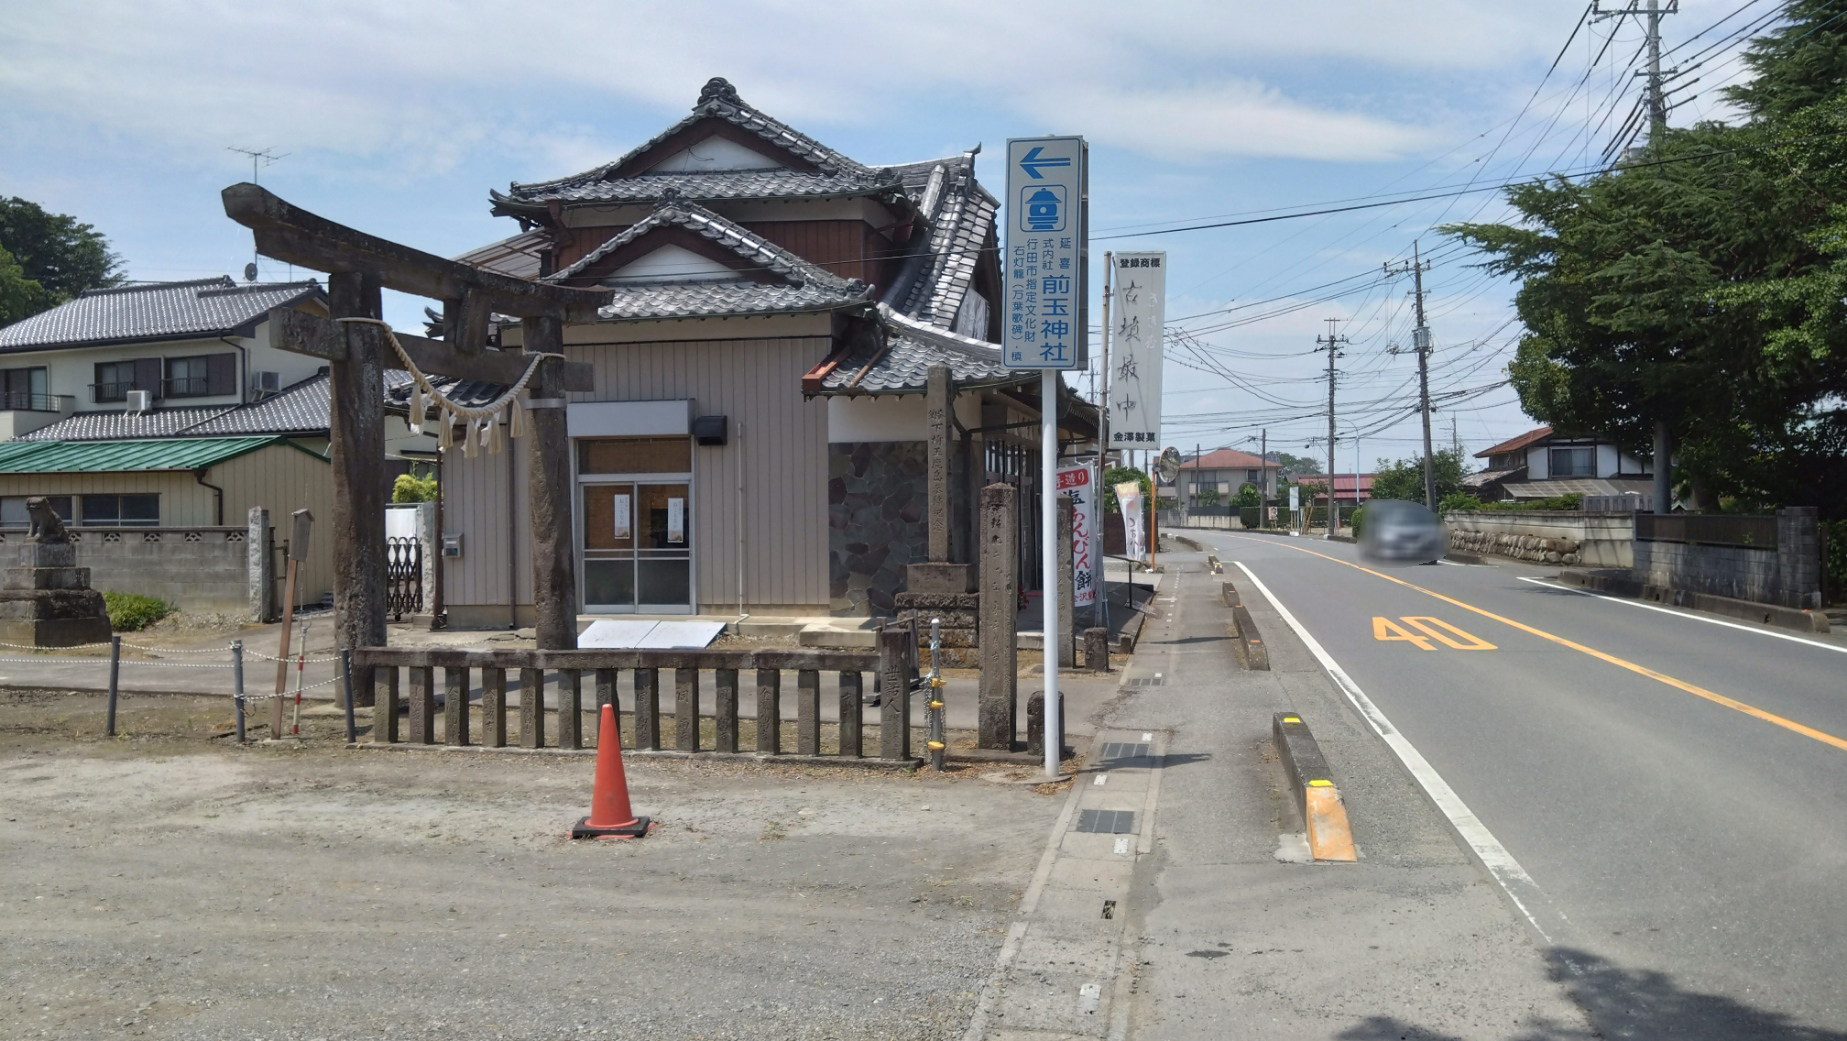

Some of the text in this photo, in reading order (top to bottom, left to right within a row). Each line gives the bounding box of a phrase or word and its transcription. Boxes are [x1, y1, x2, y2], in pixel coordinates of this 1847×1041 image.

[1042, 238, 1054, 270] 式内社
[1120, 258, 1160, 268] 登録商標
[1024, 238, 1038, 342] 行田市指定文化財
[1040, 274, 1071, 361] 前玉神社
[1116, 280, 1142, 423] 古墳最中
[1113, 431, 1156, 442] 金澤製菓
[1372, 617, 1498, 650] 40
[884, 664, 901, 713] 世話人
